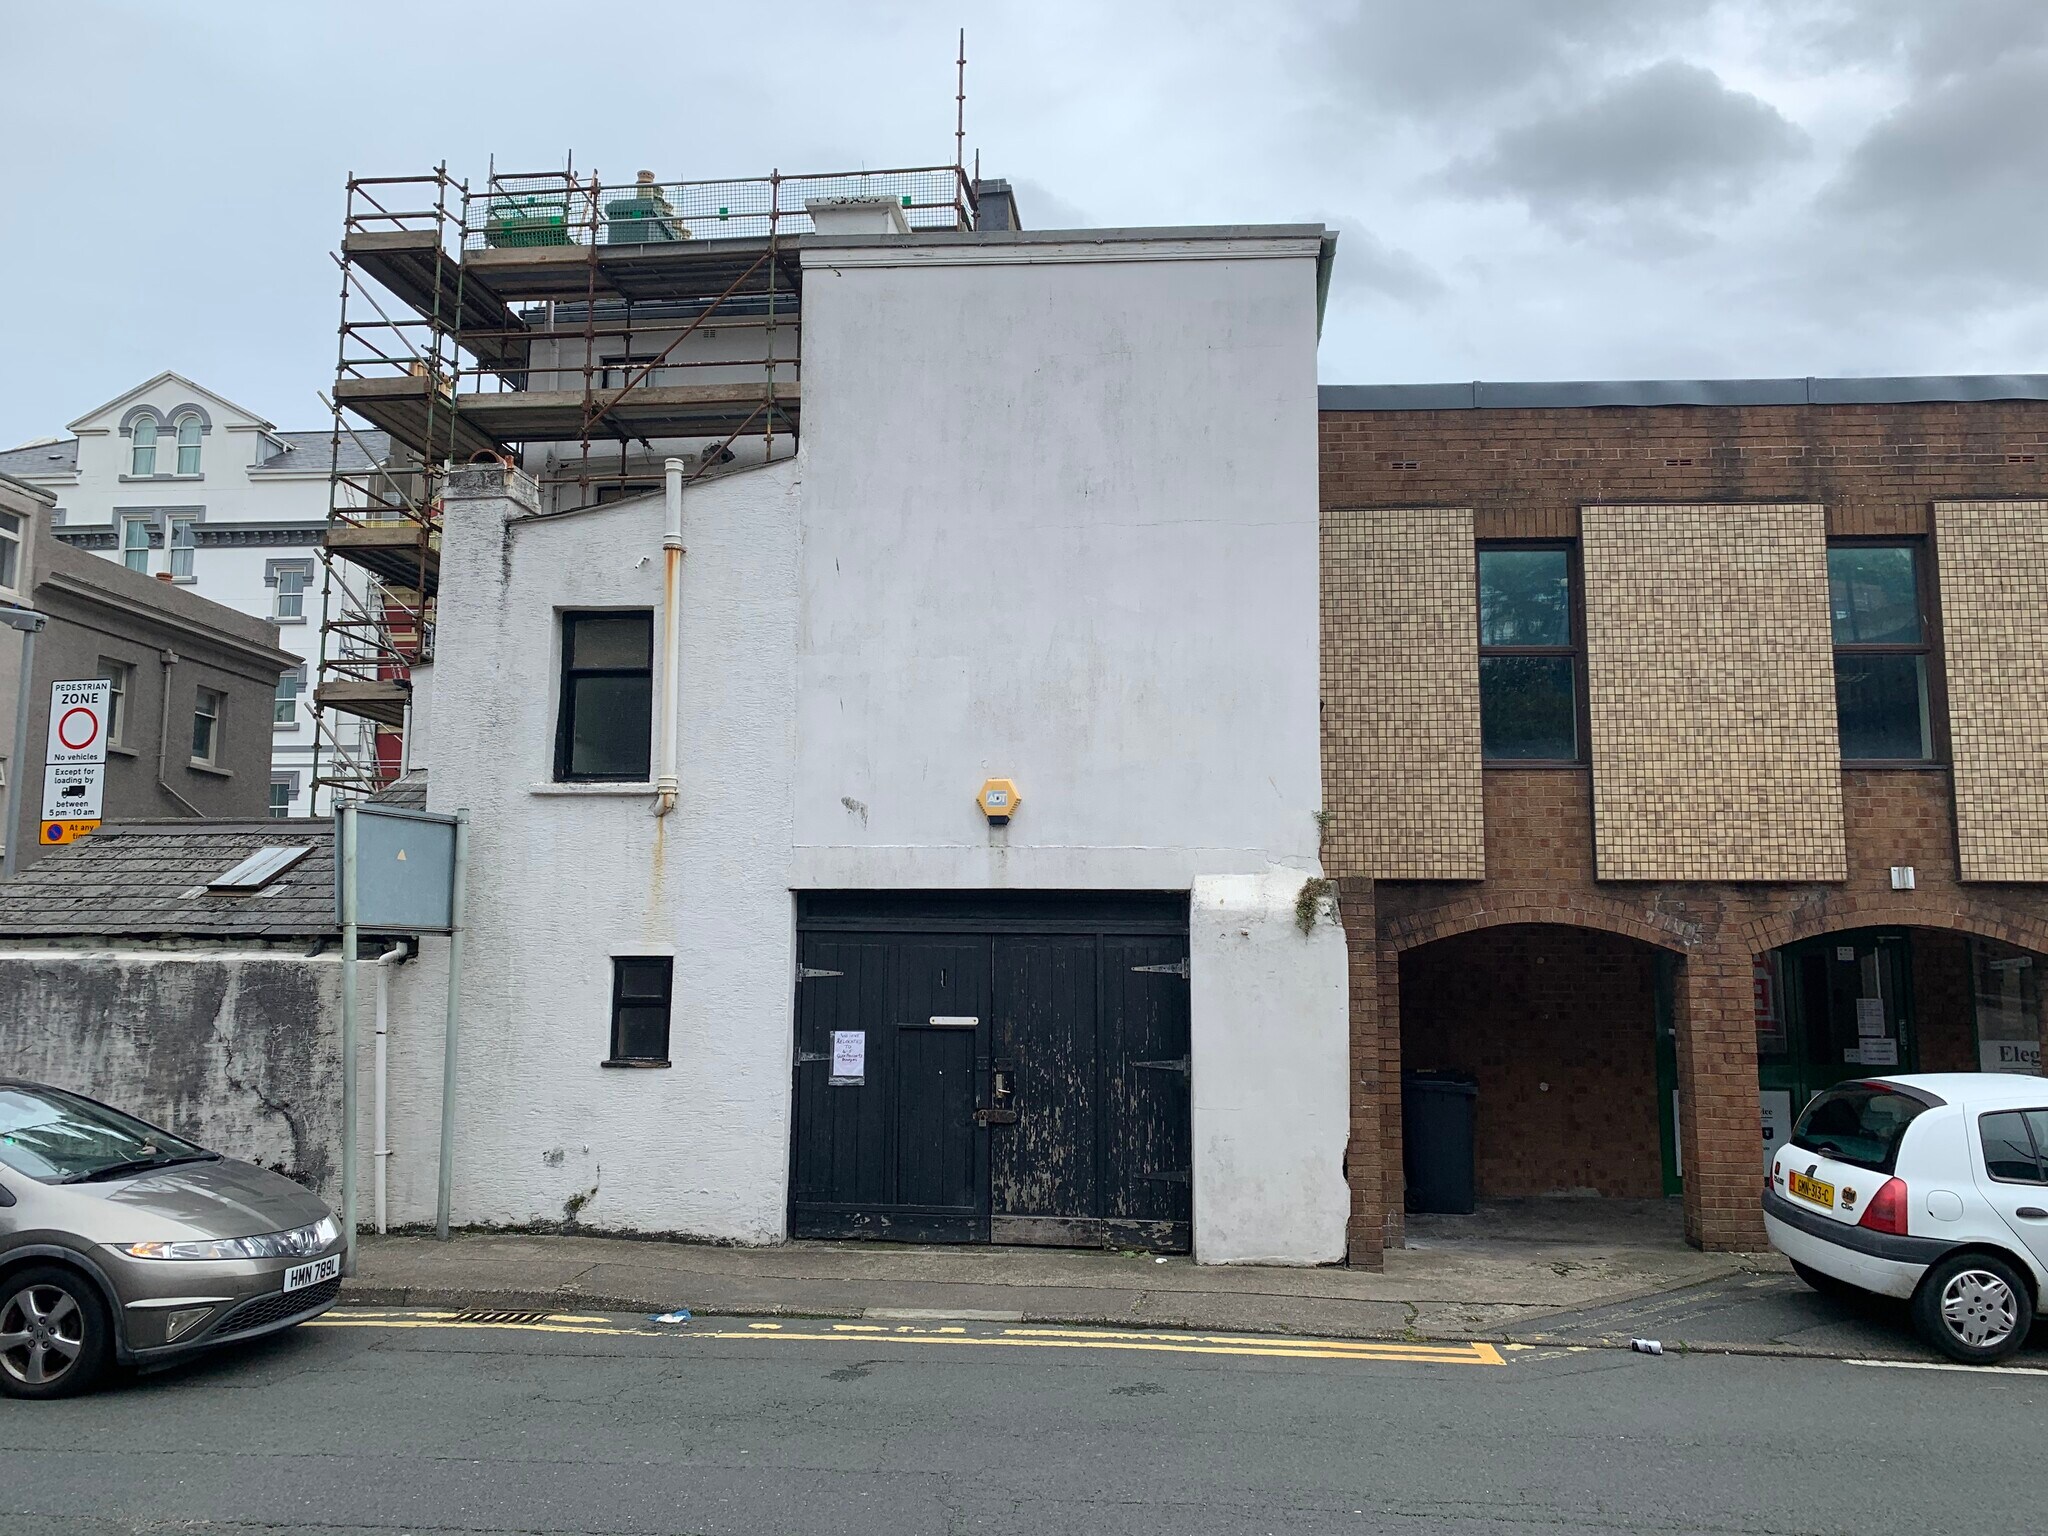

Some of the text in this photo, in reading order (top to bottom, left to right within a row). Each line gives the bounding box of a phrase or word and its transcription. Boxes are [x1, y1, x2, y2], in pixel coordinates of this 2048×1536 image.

[55, 683, 107, 691] PEDESTRIAN
[61, 693, 99, 704] ZONE
[55, 768, 81, 776] Except
[987, 793, 1007, 803] ADT
[1797, 1179, 1829, 1202] GMN-313-C
[290, 1258, 337, 1287] HMN 789L
